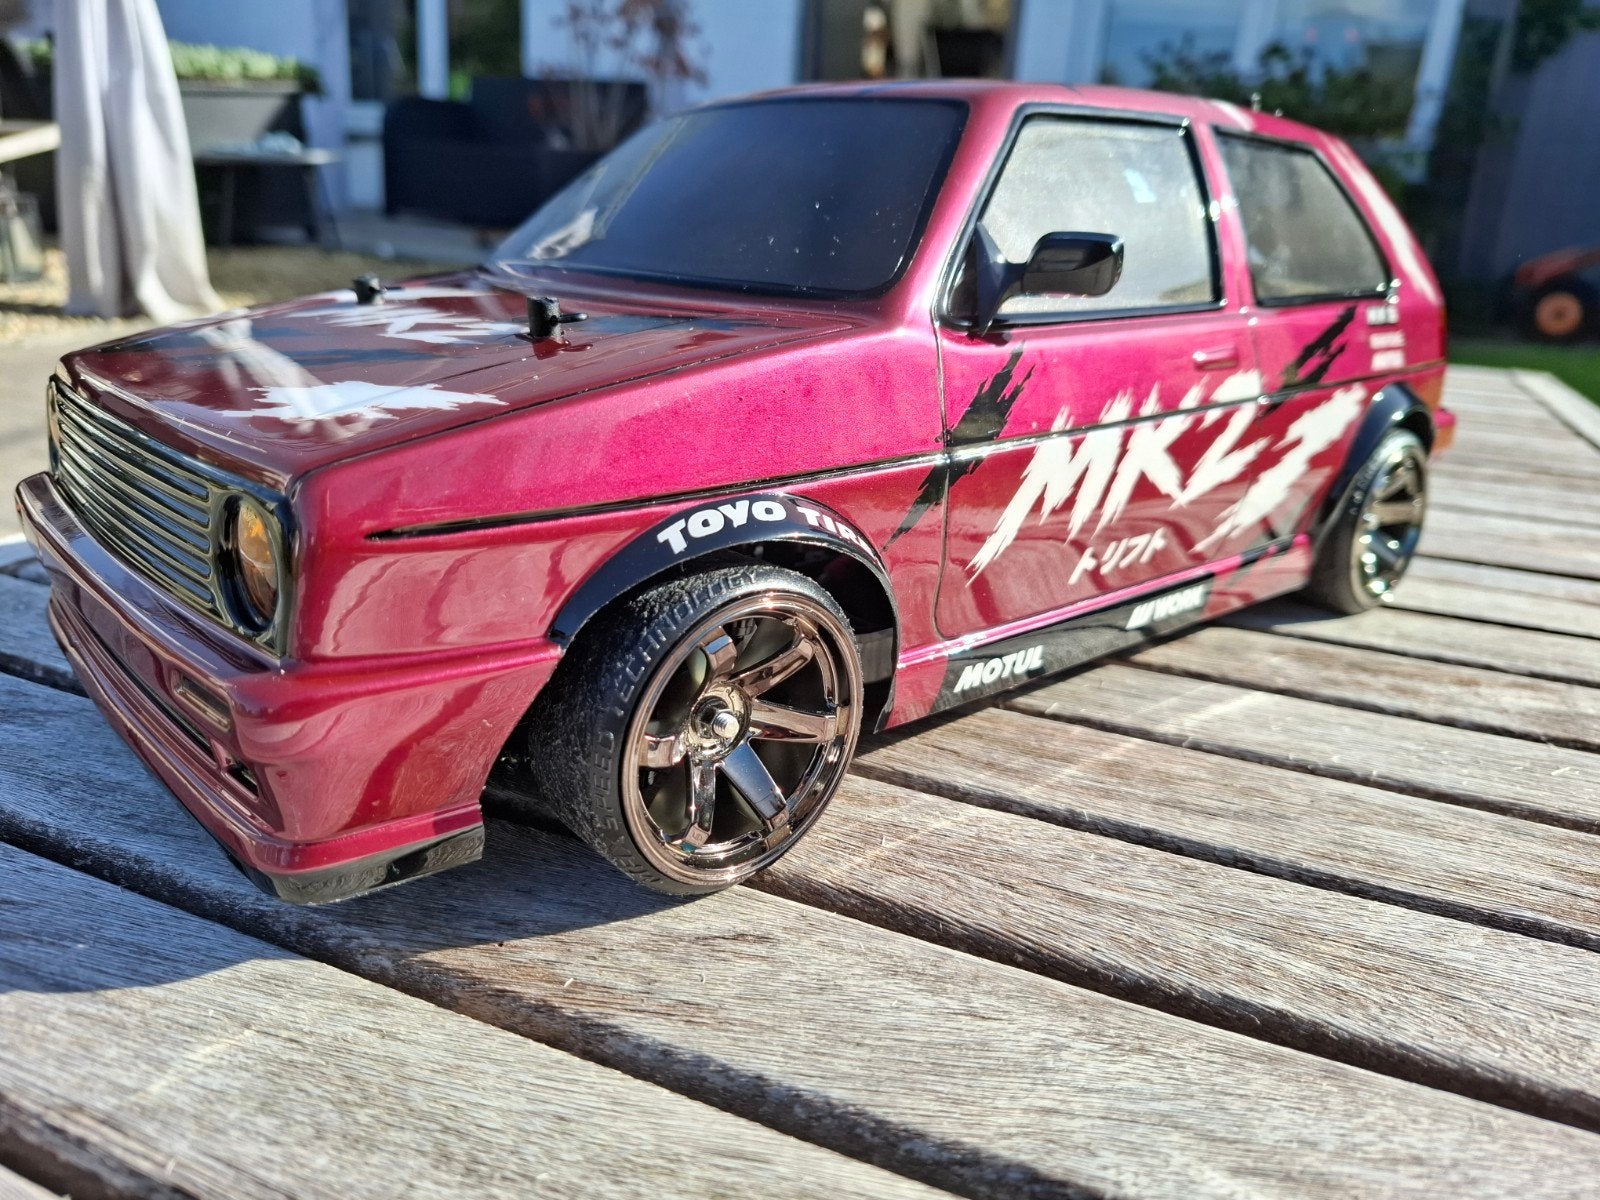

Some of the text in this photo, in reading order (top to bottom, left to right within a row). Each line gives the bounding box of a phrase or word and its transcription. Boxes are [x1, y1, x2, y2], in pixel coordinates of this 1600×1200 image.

[964, 368, 1270, 587] MK2
[656, 499, 881, 566] TOYO TIR
[953, 645, 1045, 693] MOTUL
